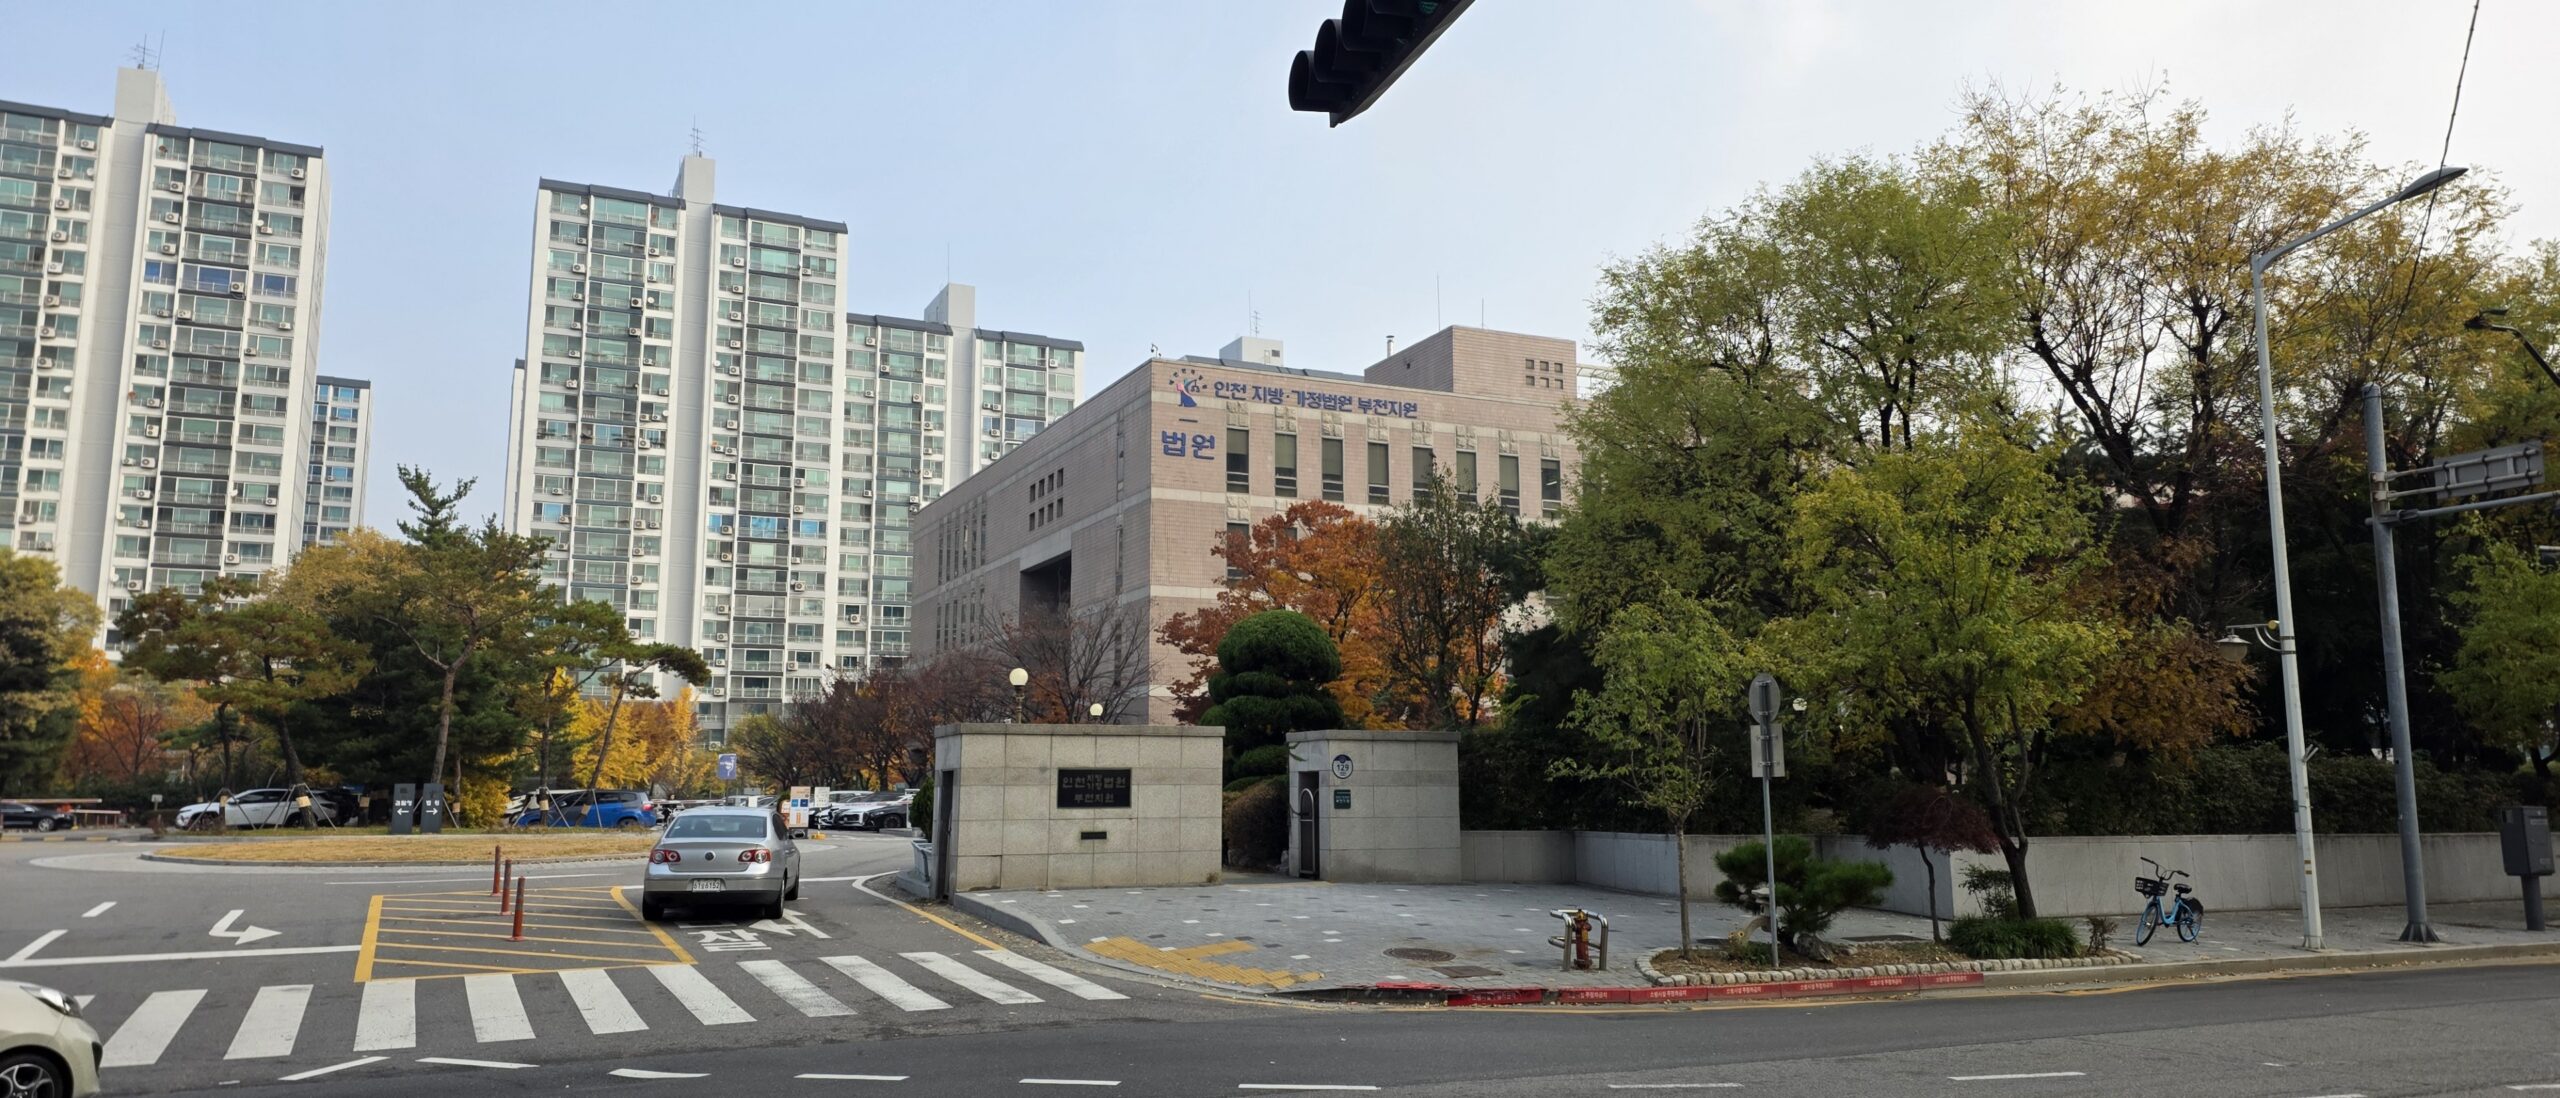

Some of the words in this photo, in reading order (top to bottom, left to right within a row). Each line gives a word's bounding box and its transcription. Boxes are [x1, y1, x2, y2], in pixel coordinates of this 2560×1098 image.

[1213, 380, 1248, 401] 인천
[1357, 396, 1418, 419] 부천지원
[1161, 430, 1216, 461] 법원
